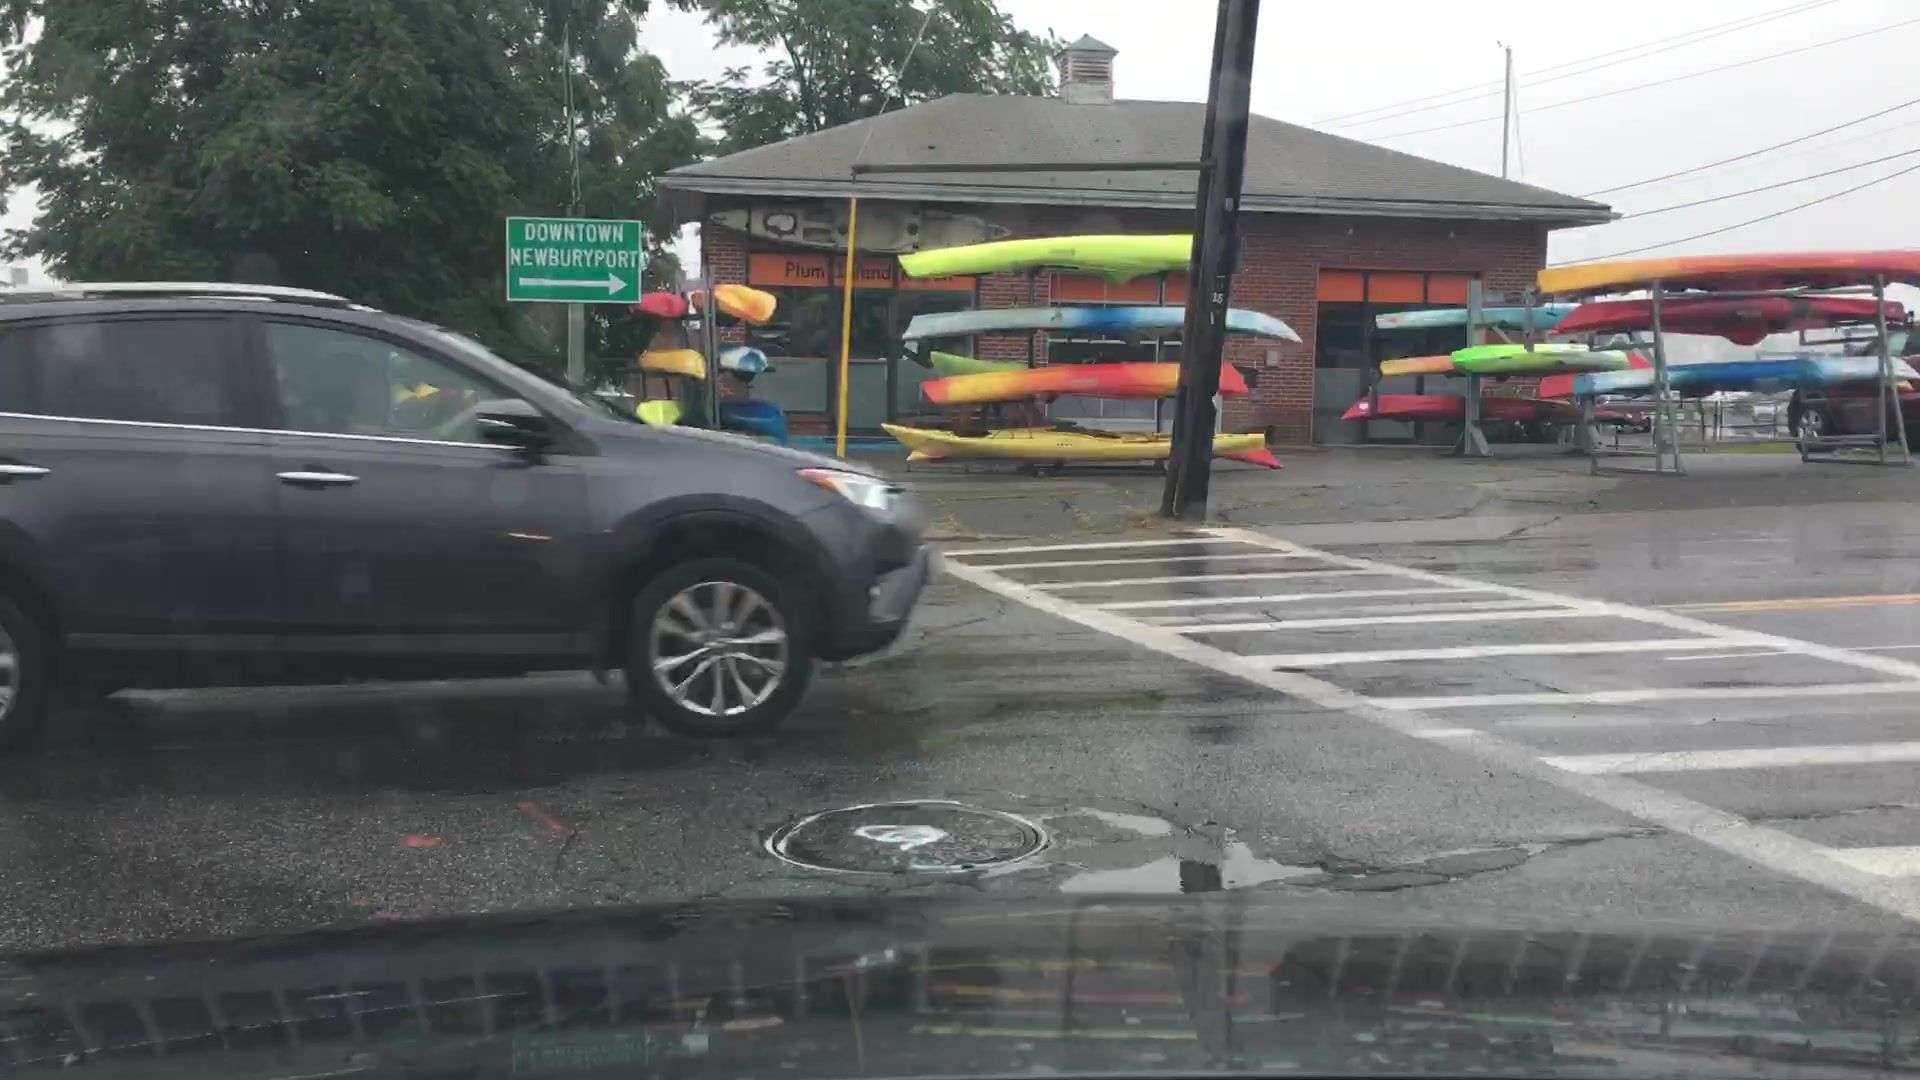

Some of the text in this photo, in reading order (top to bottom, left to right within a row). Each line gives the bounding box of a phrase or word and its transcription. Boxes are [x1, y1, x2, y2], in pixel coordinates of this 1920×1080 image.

[524, 222, 624, 243] DOWNTOWN
[510, 247, 638, 268] NEWBURYPORT
[785, 262, 825, 279] Plum
[836, 263, 891, 280] Iland
